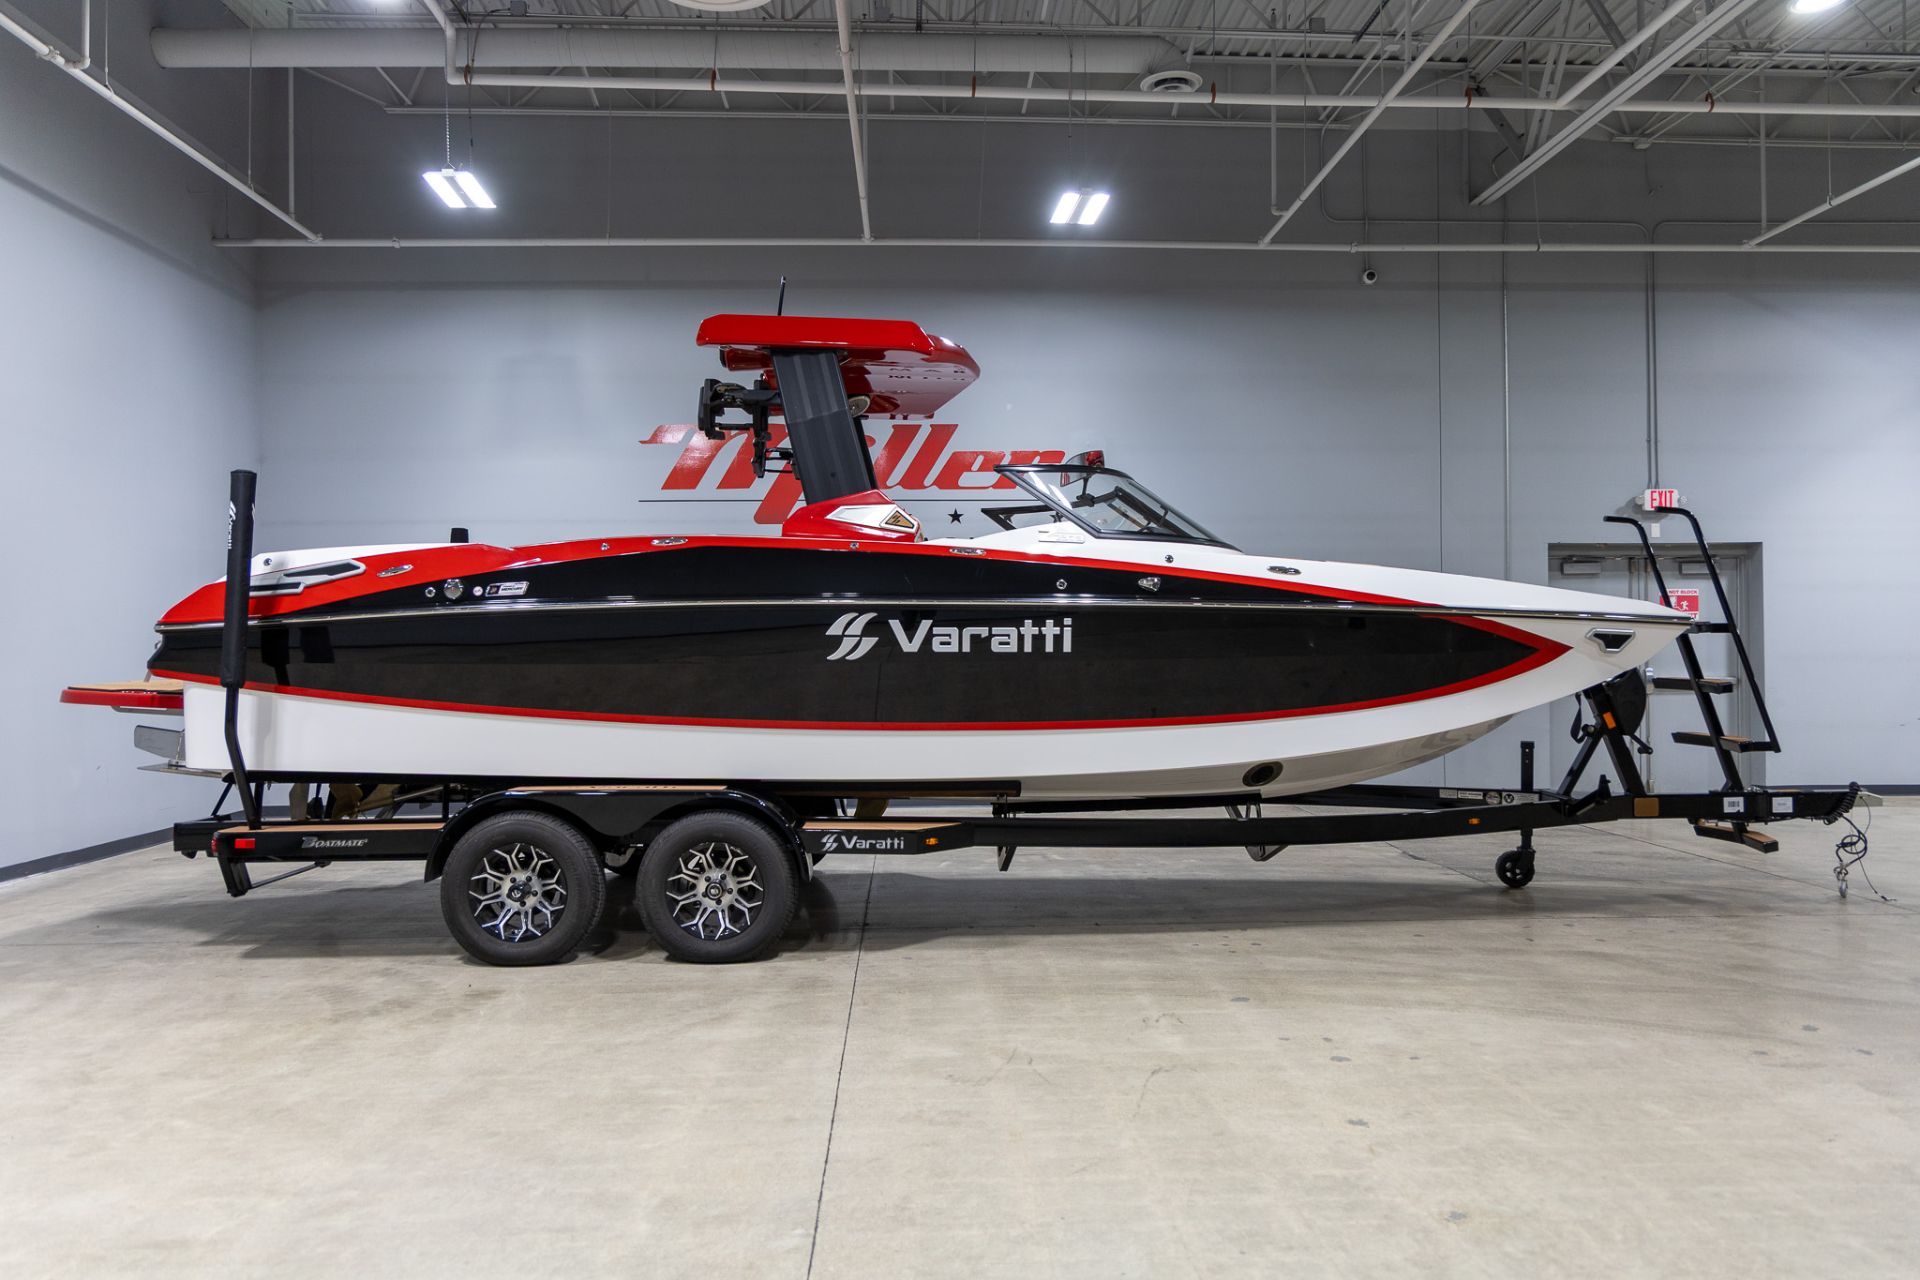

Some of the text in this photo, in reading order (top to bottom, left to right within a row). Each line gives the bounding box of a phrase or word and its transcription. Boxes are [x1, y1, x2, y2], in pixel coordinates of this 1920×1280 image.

[1650, 490, 1674, 509] EXIT
[888, 618, 1072, 653] Varatti
[840, 835, 904, 849] Varatti
